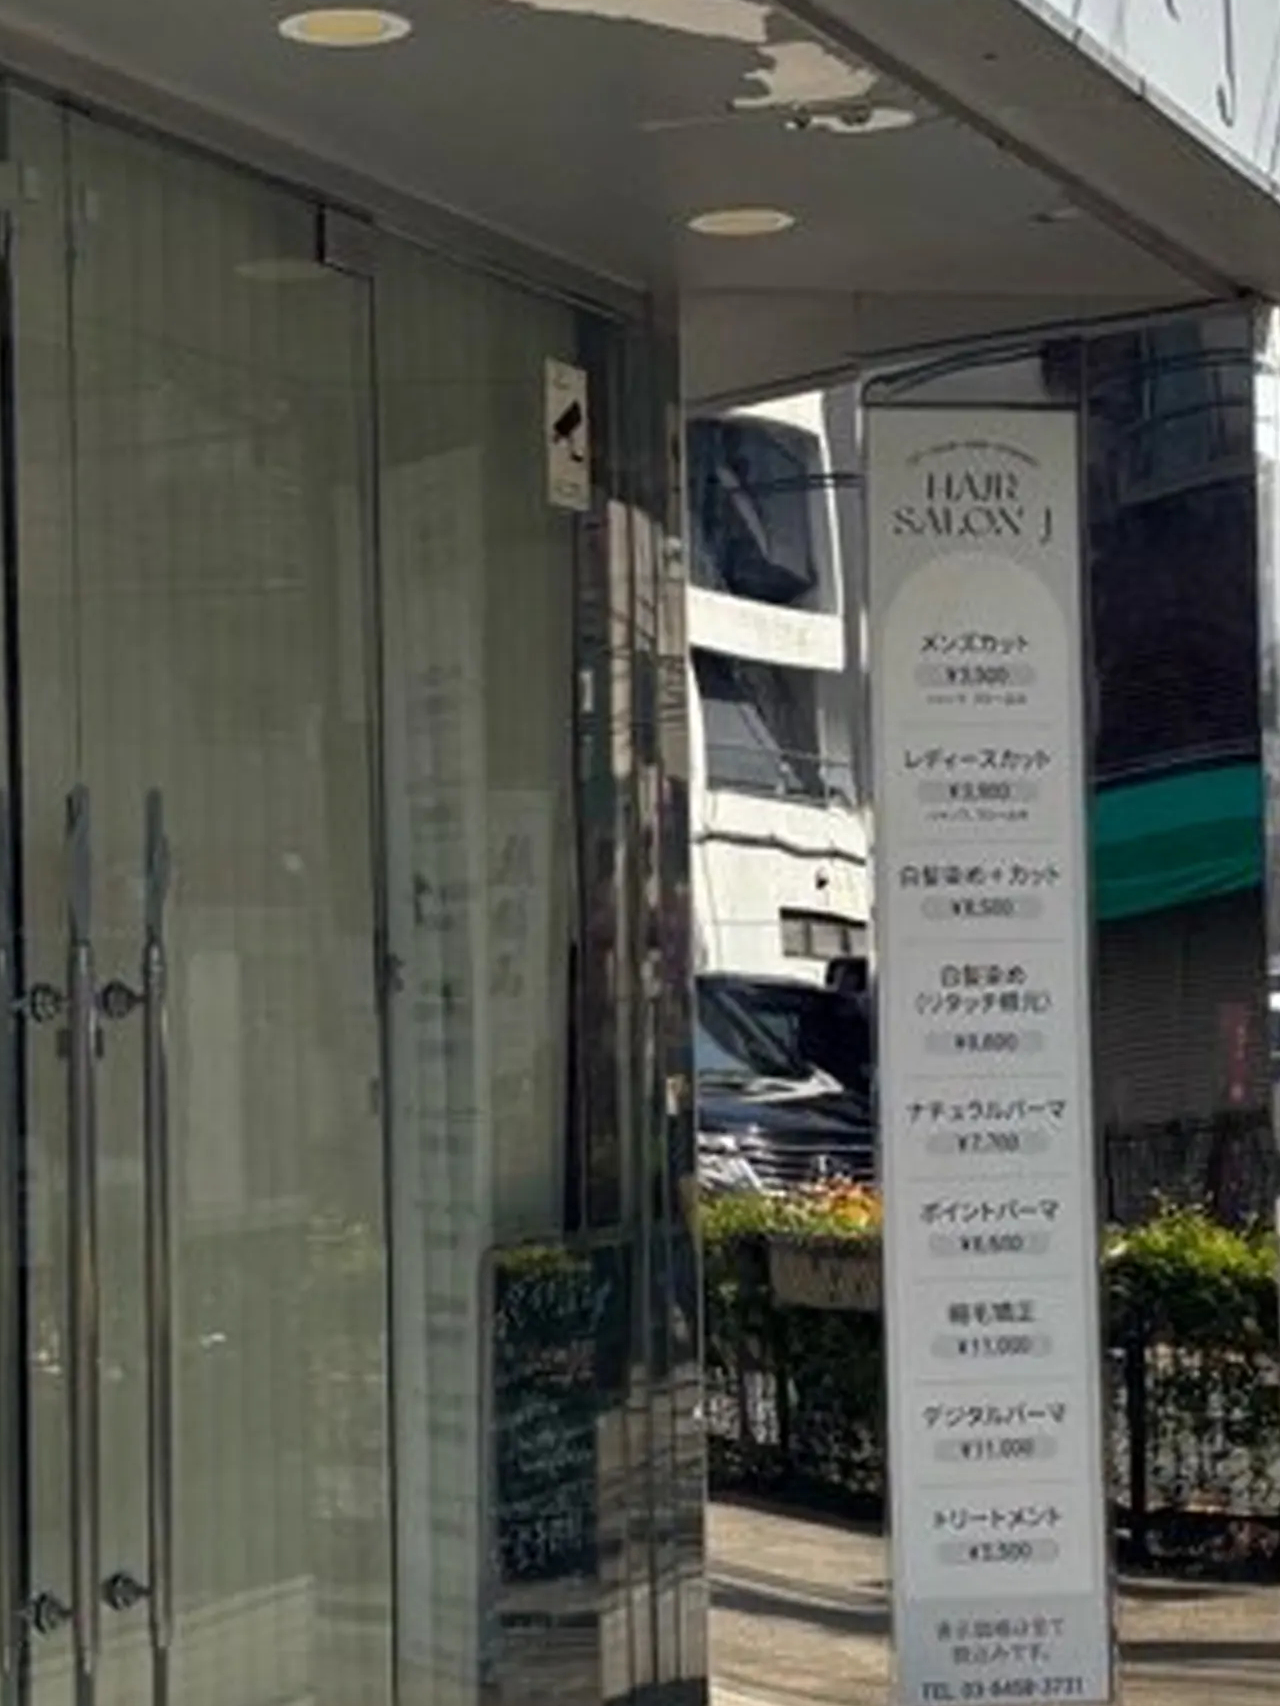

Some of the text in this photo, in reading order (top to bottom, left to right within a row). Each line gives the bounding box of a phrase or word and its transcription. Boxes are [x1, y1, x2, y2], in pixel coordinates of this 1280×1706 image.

[893, 505, 1025, 536] SALON
[920, 630, 1030, 656] メンズカット
[904, 747, 1053, 772] レディースカット
[905, 1098, 1067, 1124] ナチュラルパーマ
[921, 1199, 1061, 1225] ポイントパーマ
[921, 1401, 1068, 1429] デジタルパーマ
[931, 1505, 1063, 1530] トリートメント
